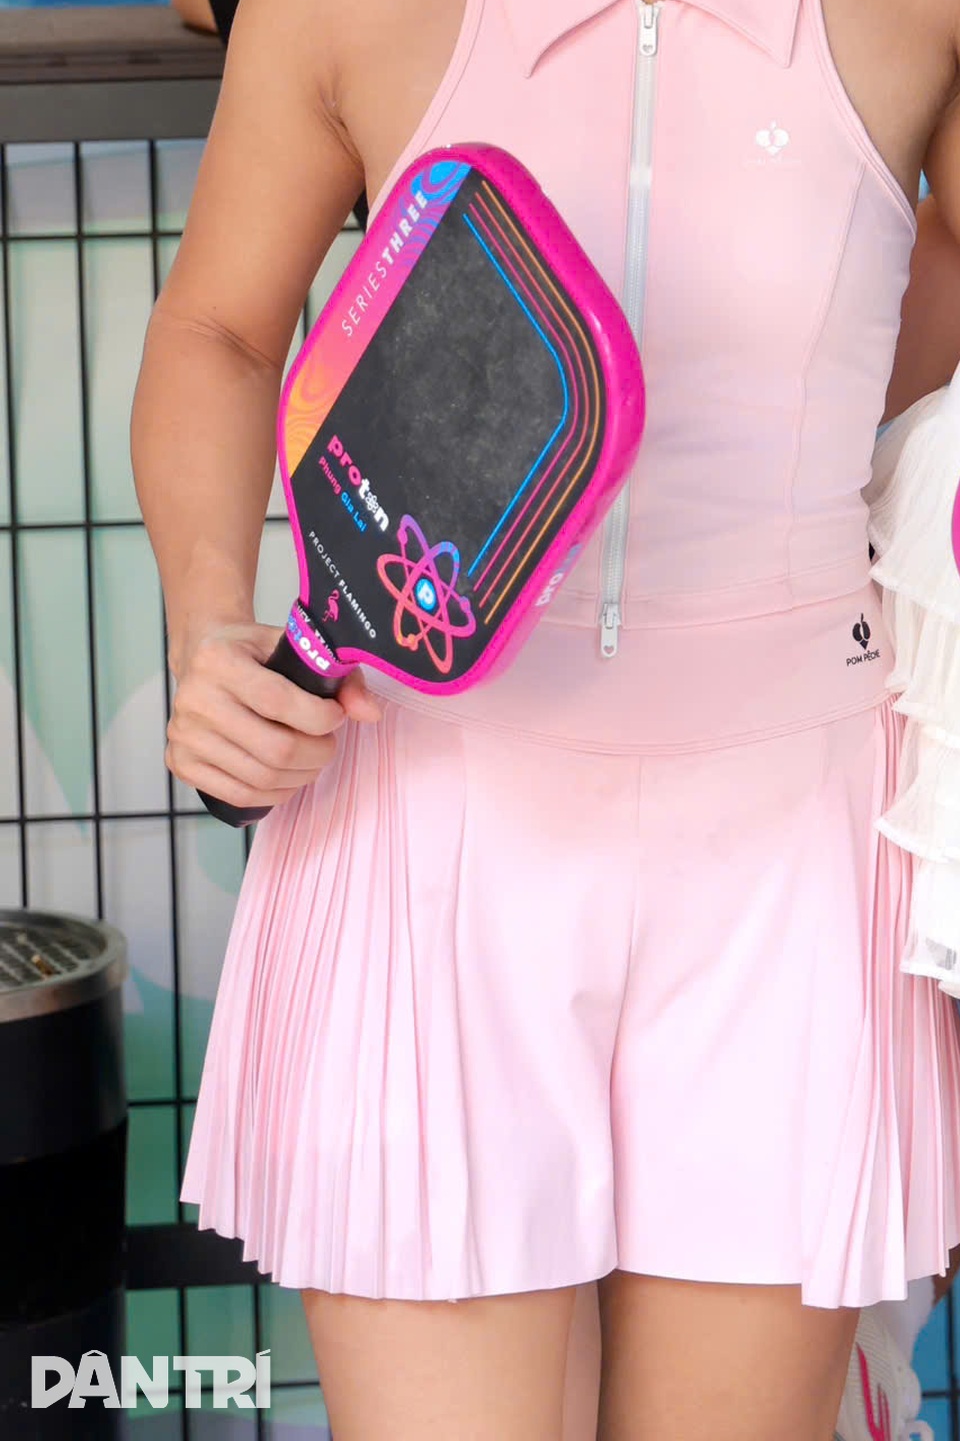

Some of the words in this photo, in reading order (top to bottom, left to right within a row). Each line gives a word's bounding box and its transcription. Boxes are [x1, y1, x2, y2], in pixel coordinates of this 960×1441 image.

[319, 456, 342, 495] Phung
[327, 434, 389, 532] proton
[309, 531, 340, 578] PROJECT
[339, 579, 376, 639] FLAMINGO
[846, 655, 863, 667] POM
